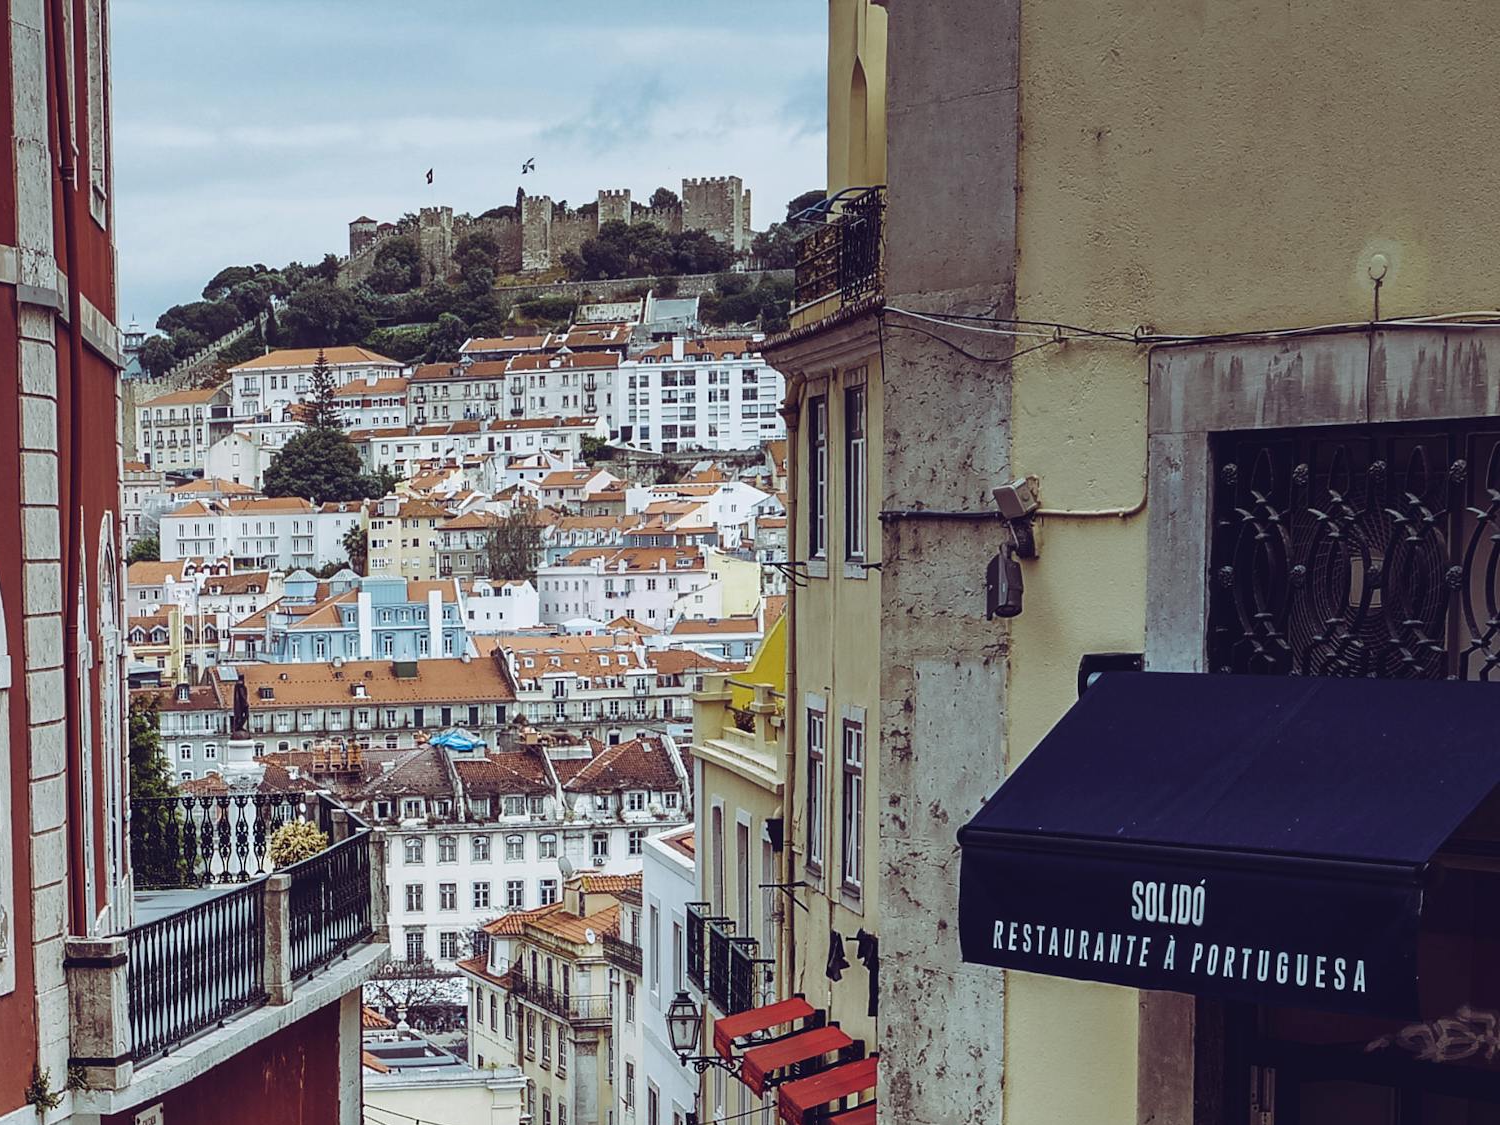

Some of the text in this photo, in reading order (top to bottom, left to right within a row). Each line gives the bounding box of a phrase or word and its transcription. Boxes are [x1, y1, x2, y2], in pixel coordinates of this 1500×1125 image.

[1131, 879, 1206, 927] SOLIDÓ
[993, 919, 1367, 993] RESTAURANTE À PORTUGUESA
